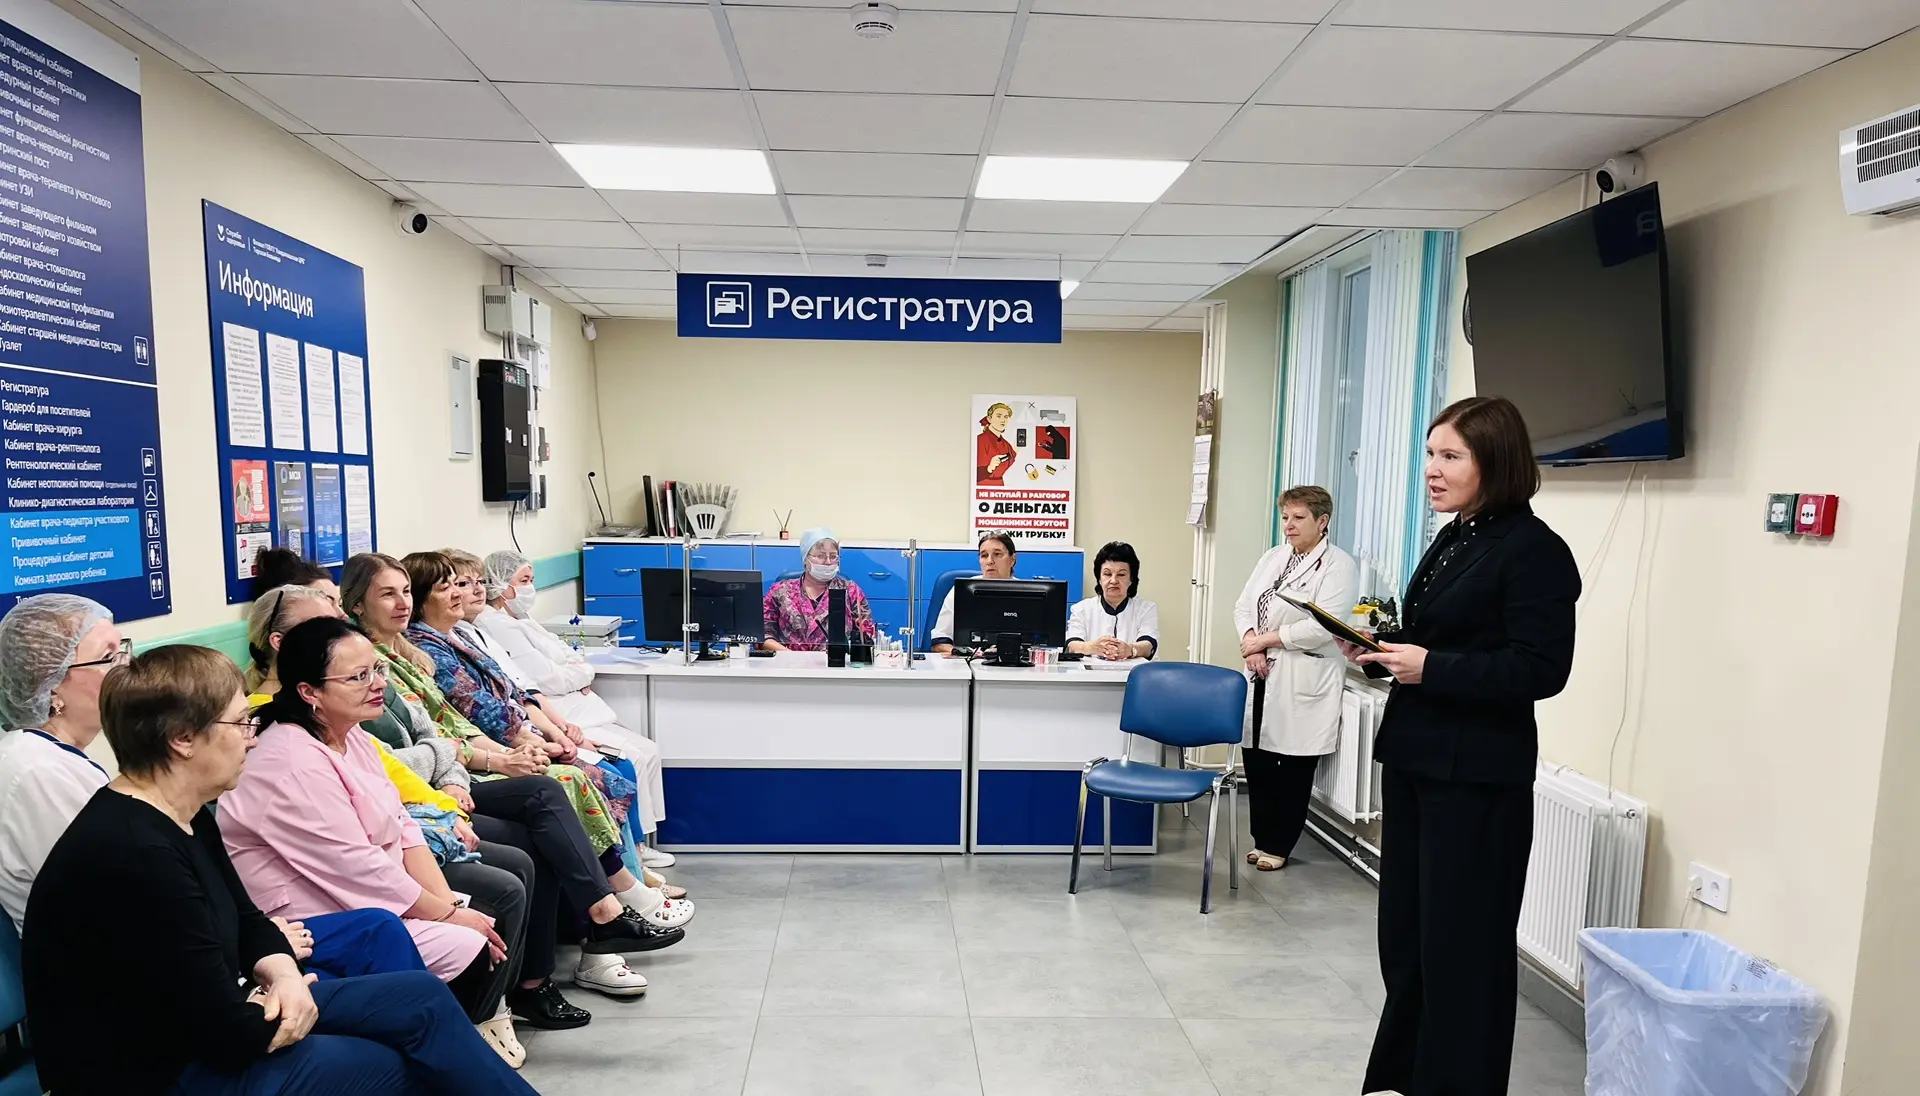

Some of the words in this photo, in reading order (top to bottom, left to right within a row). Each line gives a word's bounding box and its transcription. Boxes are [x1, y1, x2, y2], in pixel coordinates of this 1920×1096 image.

[46, 58, 74, 79] кабинет
[12, 57, 33, 76] врача
[34, 69, 57, 86] общей
[57, 80, 87, 103] практики
[32, 86, 60, 106] кабинет
[32, 103, 60, 122] кабинет
[14, 110, 72, 145] функциональной
[72, 138, 110, 161] диагностики
[16, 131, 74, 162] врача-невролога
[34, 156, 50, 169] пост
[18, 167, 74, 195] врача-терапевта
[74, 188, 112, 209] участкового
[20, 182, 34, 198] УЗИ
[0, 194, 18, 211] инет
[20, 202, 65, 225] заведующего
[66, 216, 97, 236] филиалом
[22, 221, 66, 242] заведующего
[66, 235, 102, 254] хозяйством
[32, 240, 60, 257] кабинет
[24, 256, 86, 280] врача-стоматолога
[56, 280, 82, 296] кабинет
[218, 260, 314, 319] Информация
[25, 291, 70, 310] медицинской
[71, 301, 114, 320] профилактики
[767, 286, 1034, 332] Регистратура
[0, 302, 75, 326] изиотерапевтический
[76, 318, 101, 332] кабинет
[28, 326, 58, 340] старшей
[58, 332, 100, 348] медицинской
[100, 341, 122, 354] сестры
[0, 380, 50, 398] Регистратура
[2, 399, 35, 414] Гардероб
[36, 405, 49, 415] для
[50, 406, 91, 418] посетителей
[2, 418, 33, 432] Кабинет
[34, 422, 83, 436] врача-хирурга
[4, 438, 34, 451] Кабинет
[36, 442, 101, 454] врача-рентгенолога
[6, 458, 76, 471] Рентгенологический
[76, 460, 102, 472] кабинет
[7, 478, 38, 489] Кабинет
[38, 478, 79, 489] неотложной
[80, 480, 104, 490] помощи
[8, 496, 96, 508] Клинико-диагностическая
[96, 496, 134, 508] лаборатория
[990, 490, 1021, 498] ВСТУПАЙ
[978, 502, 990, 513] О
[993, 502, 1066, 514] ДЕНЬГАХ!
[10, 518, 40, 529] Кабинет
[41, 516, 93, 530] врача-педиатра
[94, 516, 130, 527] участкового
[978, 518, 1032, 526] МОШЕННИКИ
[1033, 519, 1066, 527] КРУГОМ
[12, 534, 59, 549] Прививочный
[60, 533, 86, 546] кабинет
[1025, 531, 1066, 539] ТРУБКУ!
[13, 554, 62, 568] Процедурный
[62, 550, 88, 562] кабинет
[89, 548, 114, 562] детский
[14, 574, 44, 586] Комната
[46, 571, 80, 584] здорового
[80, 567, 106, 581] ребенка
